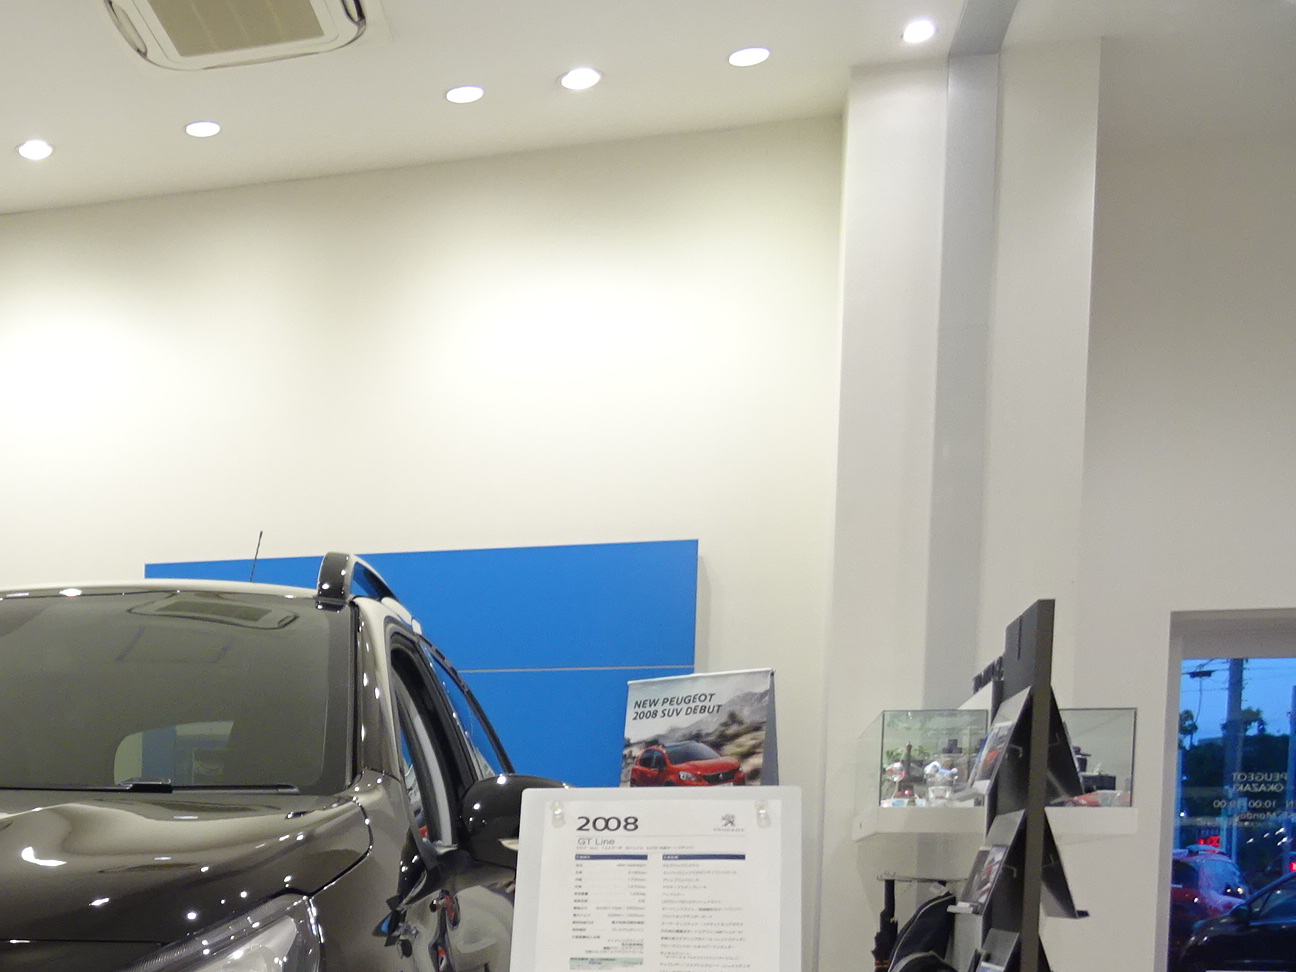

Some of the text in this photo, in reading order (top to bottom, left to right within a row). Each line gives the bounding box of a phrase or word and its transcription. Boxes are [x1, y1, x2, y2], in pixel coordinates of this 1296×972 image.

[634, 693, 716, 709] NEW PEUGEOT
[632, 704, 722, 720] 2008 SUV DEBUT
[576, 816, 639, 832] 2008
[578, 838, 615, 846] GT Line
